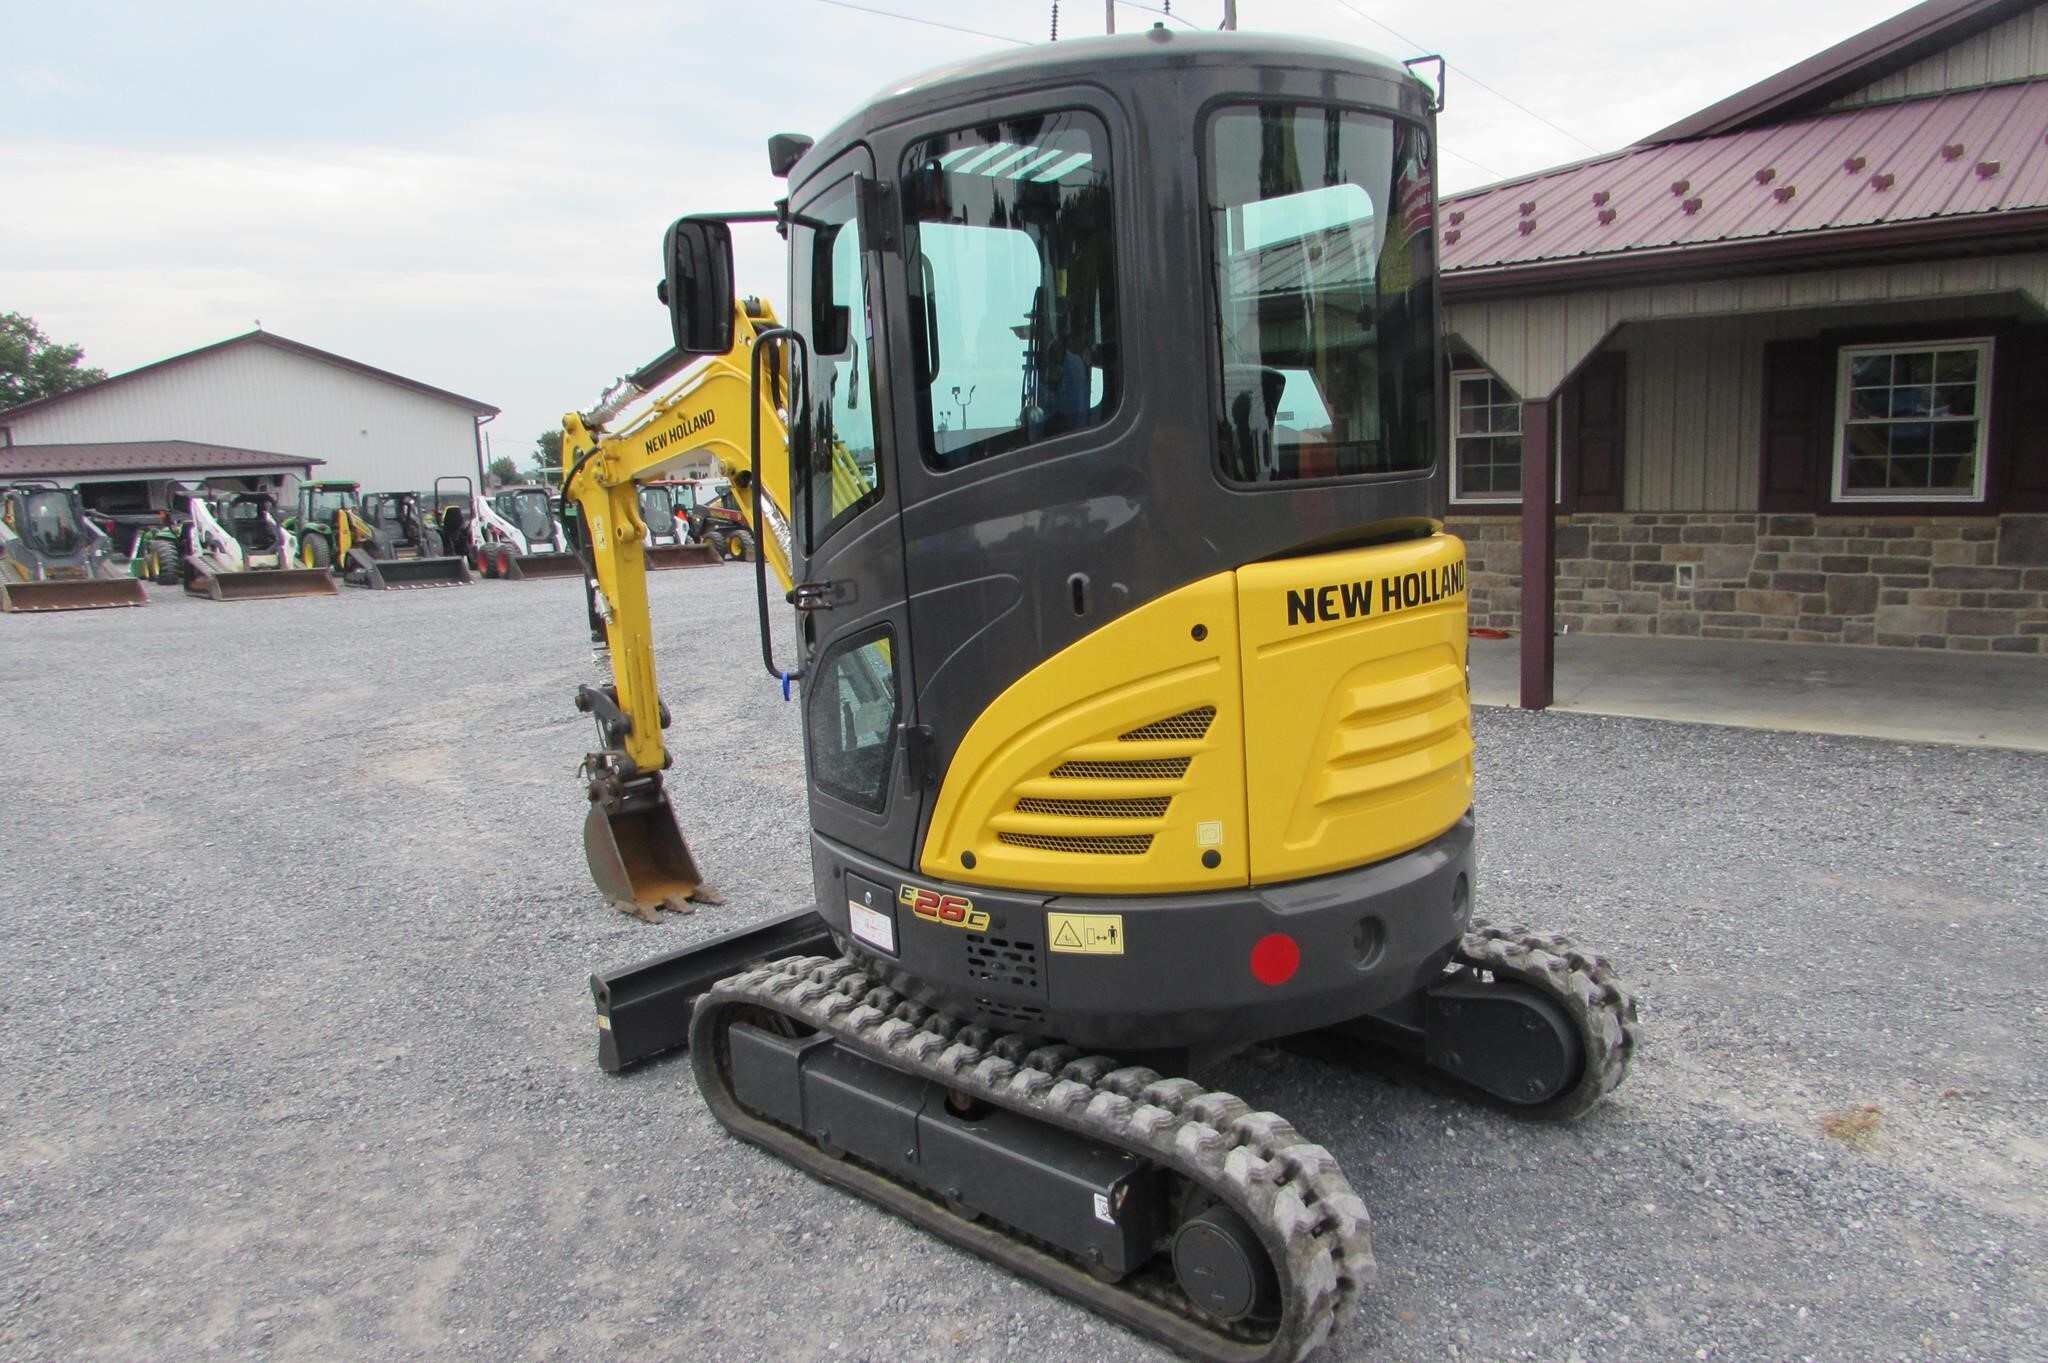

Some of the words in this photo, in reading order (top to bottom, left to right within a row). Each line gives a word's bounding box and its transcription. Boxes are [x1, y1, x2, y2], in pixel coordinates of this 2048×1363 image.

[645, 431, 668, 455] NEW
[669, 409, 716, 443] HOLLAND
[1287, 580, 1373, 625] NEW
[1381, 560, 1465, 612] HOLLAND
[900, 885, 989, 929] E26C
